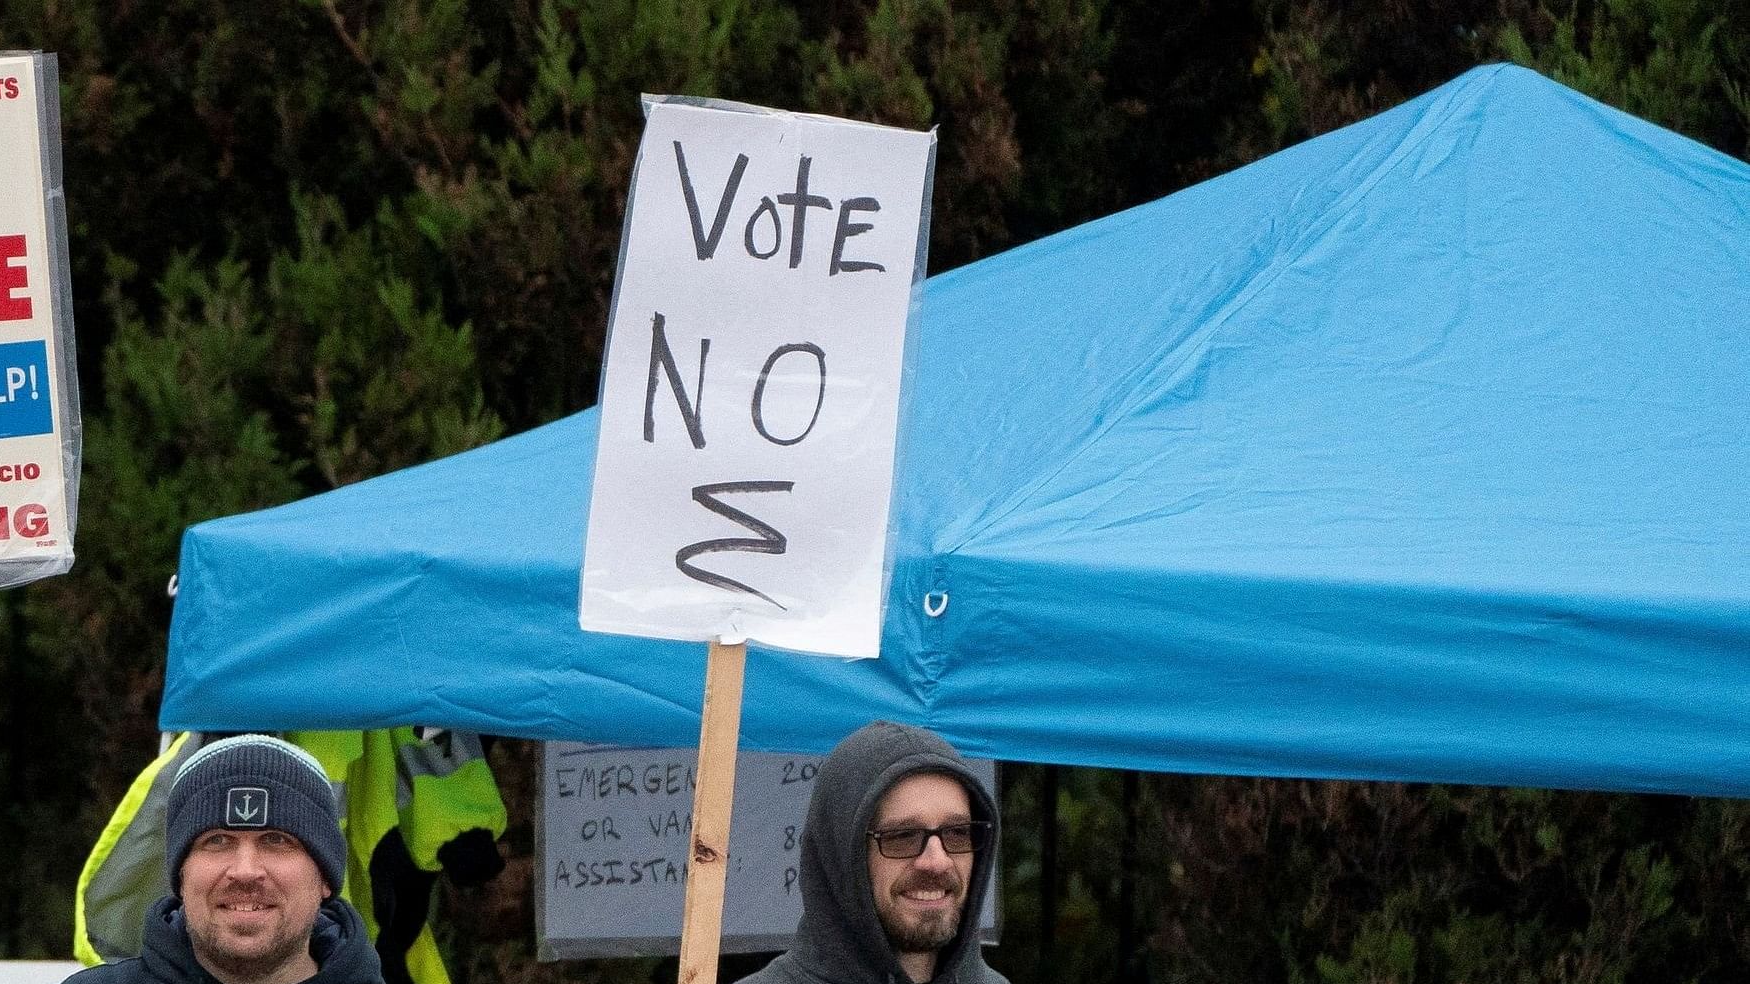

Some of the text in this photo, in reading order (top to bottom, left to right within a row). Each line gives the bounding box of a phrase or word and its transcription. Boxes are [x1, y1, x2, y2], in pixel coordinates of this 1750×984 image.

[642, 311, 827, 450] NO
[555, 764, 697, 800] EMERGEN
[581, 816, 621, 841] OR
